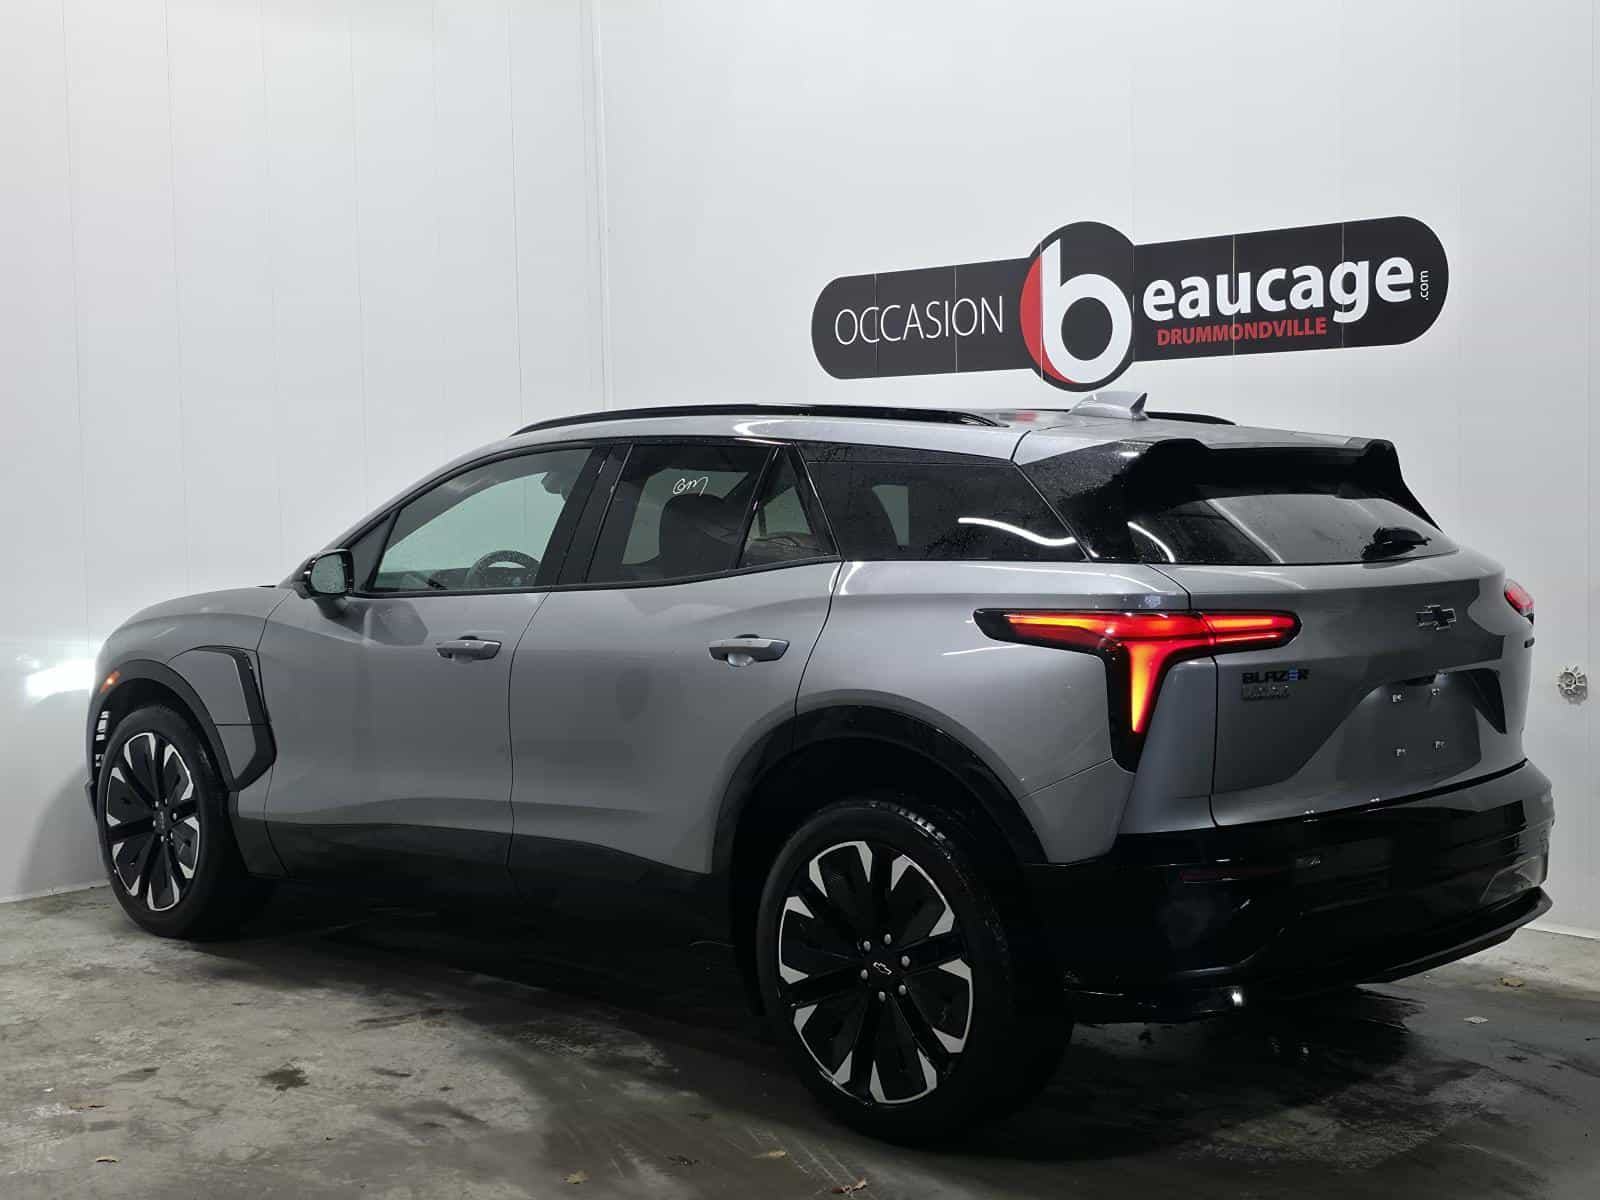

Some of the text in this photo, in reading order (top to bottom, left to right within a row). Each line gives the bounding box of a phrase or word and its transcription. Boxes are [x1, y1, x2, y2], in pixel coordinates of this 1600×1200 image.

[834, 295, 1003, 345] OCCASION
[1157, 316, 1328, 346] DRUMMONDVILLE
[1241, 668, 1310, 684] BLAZER
